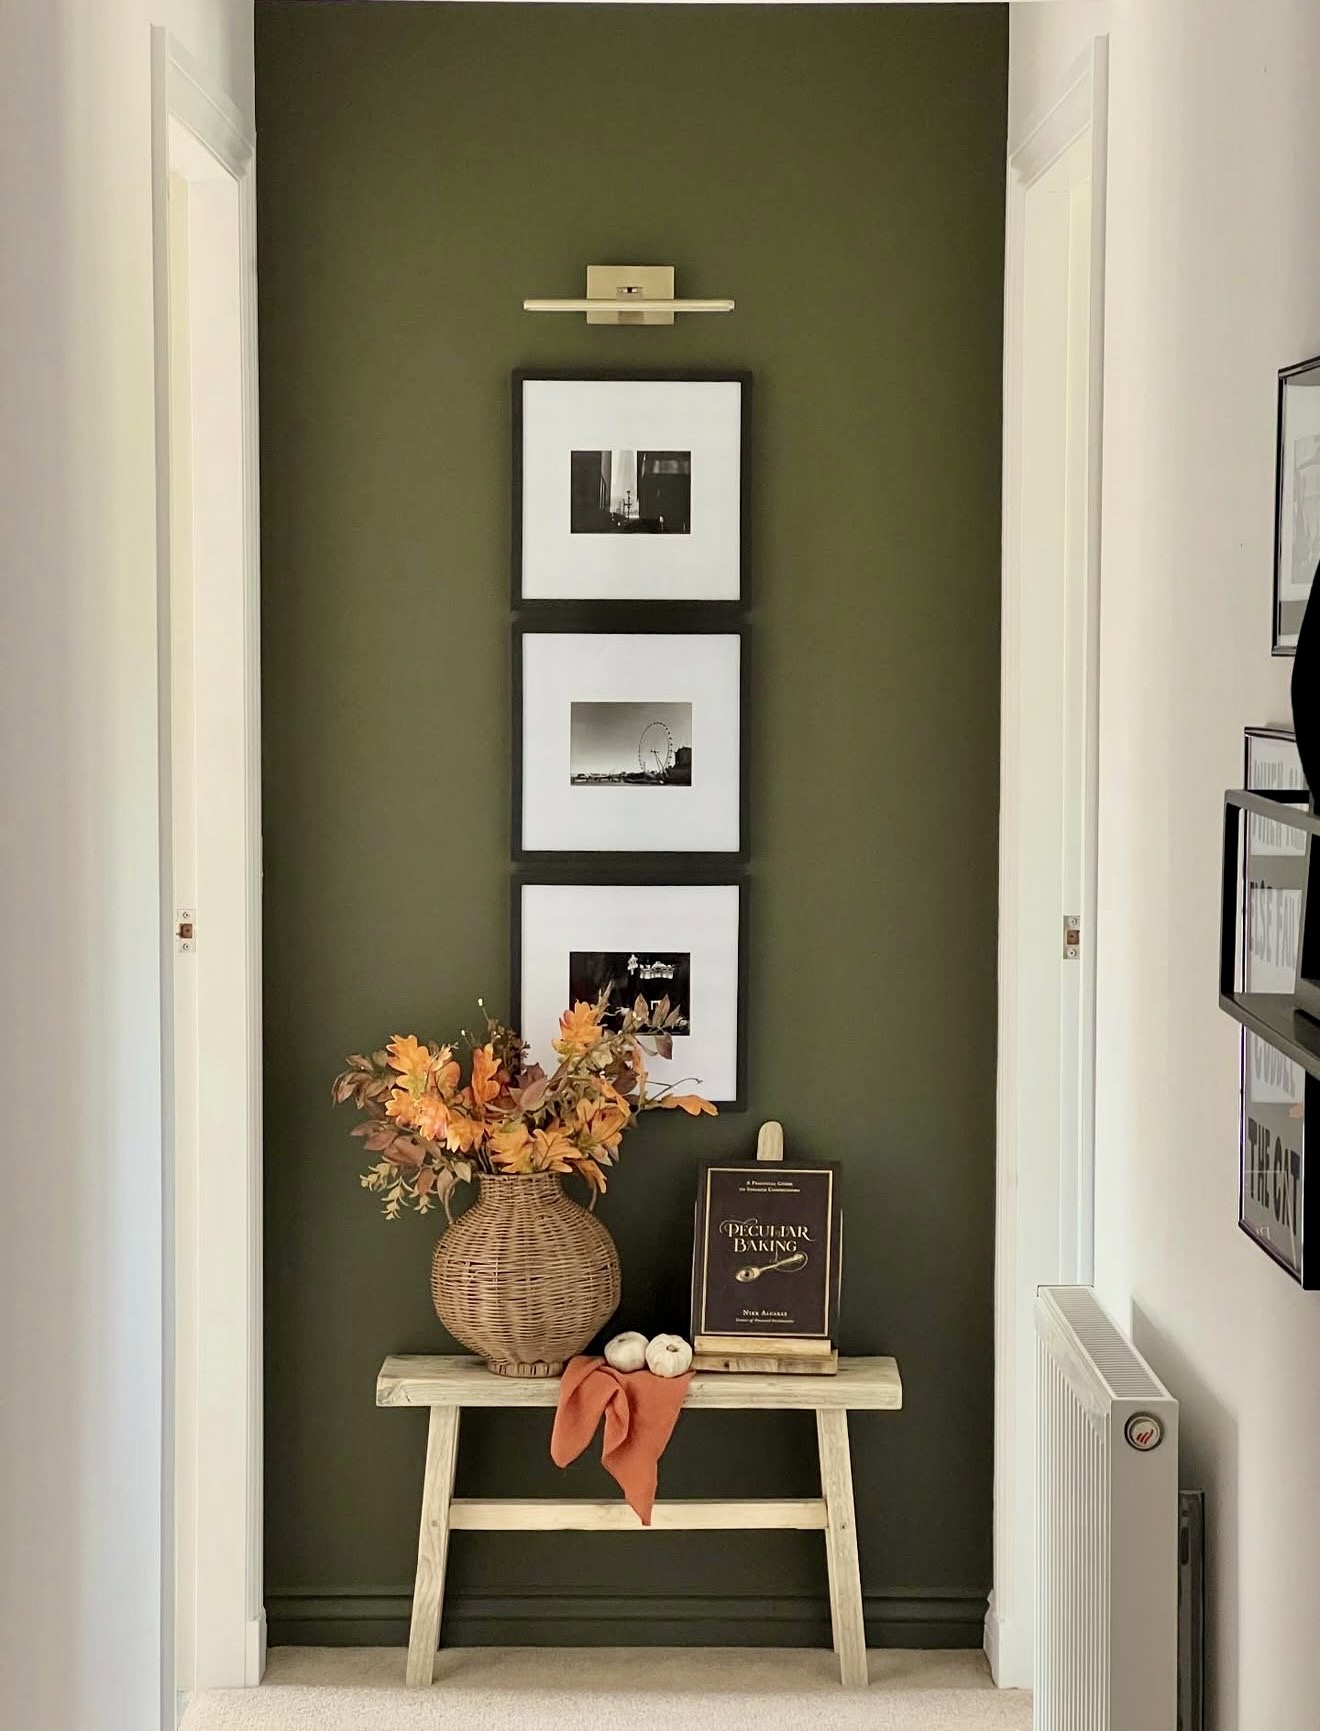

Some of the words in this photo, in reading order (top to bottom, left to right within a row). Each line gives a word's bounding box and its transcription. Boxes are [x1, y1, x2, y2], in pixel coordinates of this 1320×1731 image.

[1248, 1117, 1271, 1209] THE
[1274, 1136, 1301, 1236] CAT
[720, 1219, 814, 1240] PECULIAR
[734, 1238, 797, 1252] BAKING
